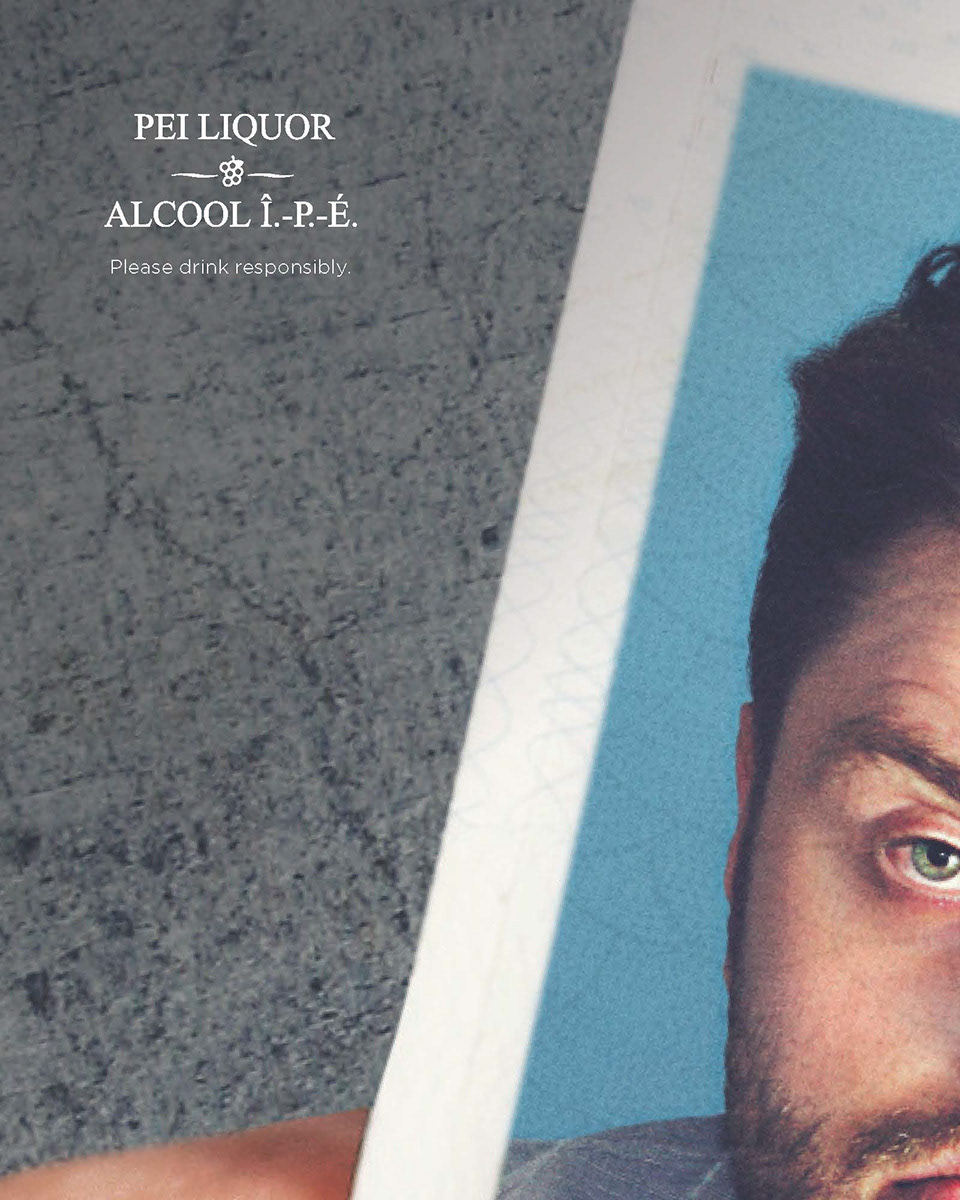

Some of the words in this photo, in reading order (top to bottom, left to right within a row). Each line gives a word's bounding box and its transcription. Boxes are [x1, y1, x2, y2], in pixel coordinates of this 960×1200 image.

[133, 113, 189, 140] PEI
[197, 113, 336, 147] LIQUOR
[104, 200, 251, 228] ALCOOL
[260, 193, 358, 228] Î.-P.-É.
[110, 259, 173, 275] Please
[179, 259, 229, 275] drink
[235, 259, 351, 278] responsibly.
